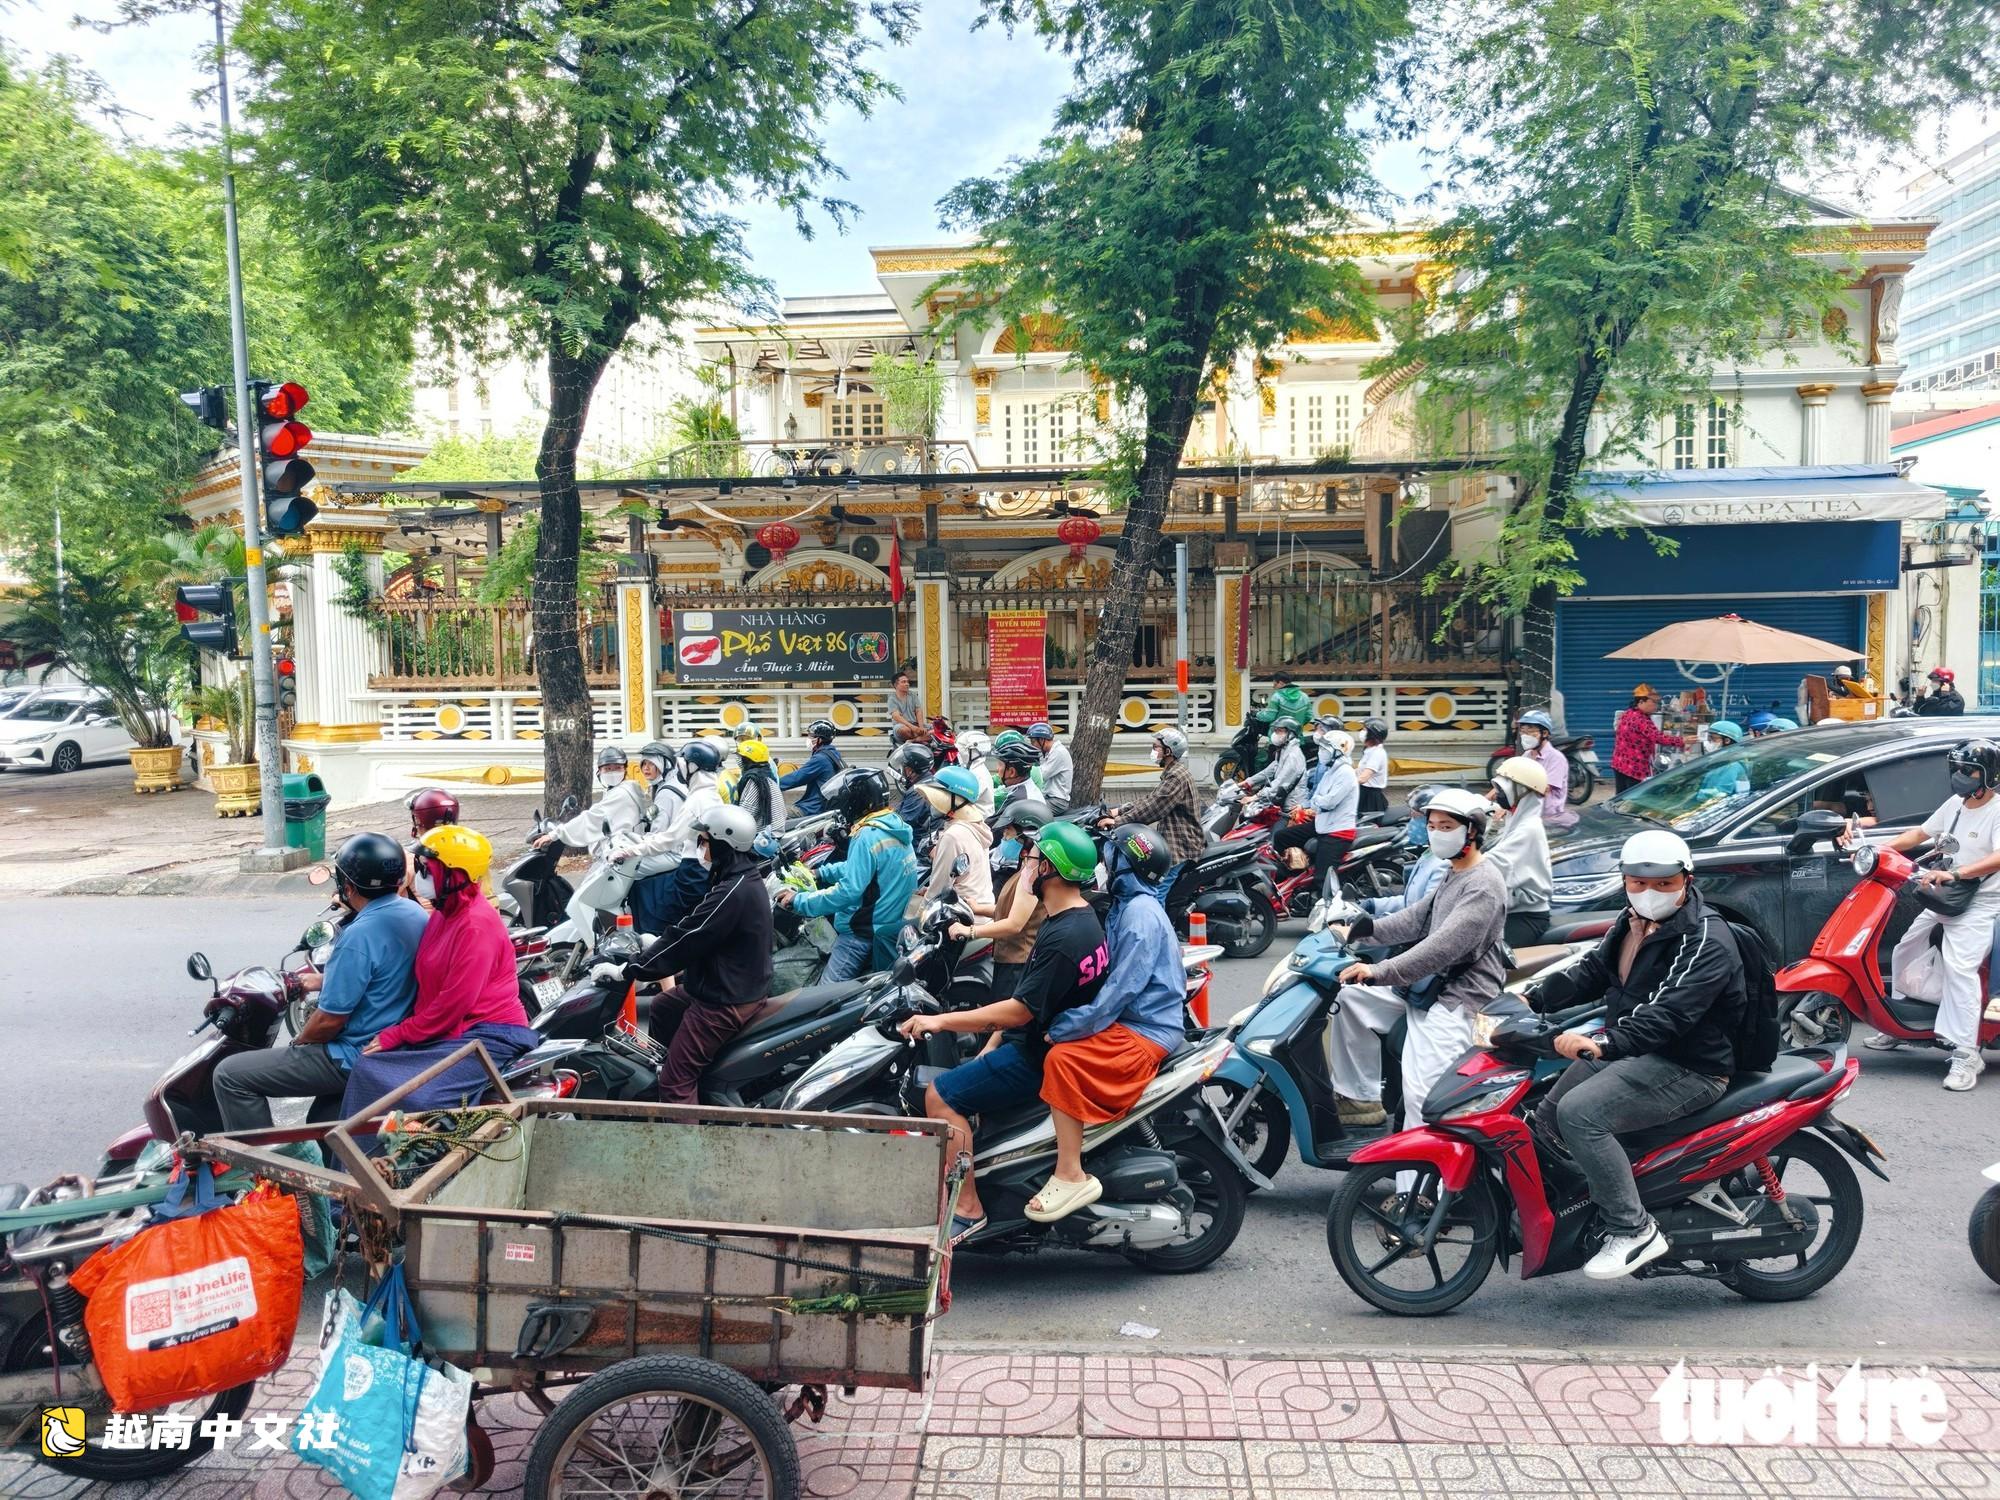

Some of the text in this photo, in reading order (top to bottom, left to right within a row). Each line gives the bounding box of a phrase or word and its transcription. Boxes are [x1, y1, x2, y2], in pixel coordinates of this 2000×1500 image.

[1691, 500, 1863, 516] CHAPA TEA
[740, 611, 826, 626] NHÀ HÀNG
[721, 629, 848, 658] Phố Việt 86
[734, 658, 836, 674] Ẩm Thực 3 Miền
[552, 718, 576, 731] 176
[1079, 936, 1110, 987] SA
[1559, 1199, 1592, 1218] HOND
